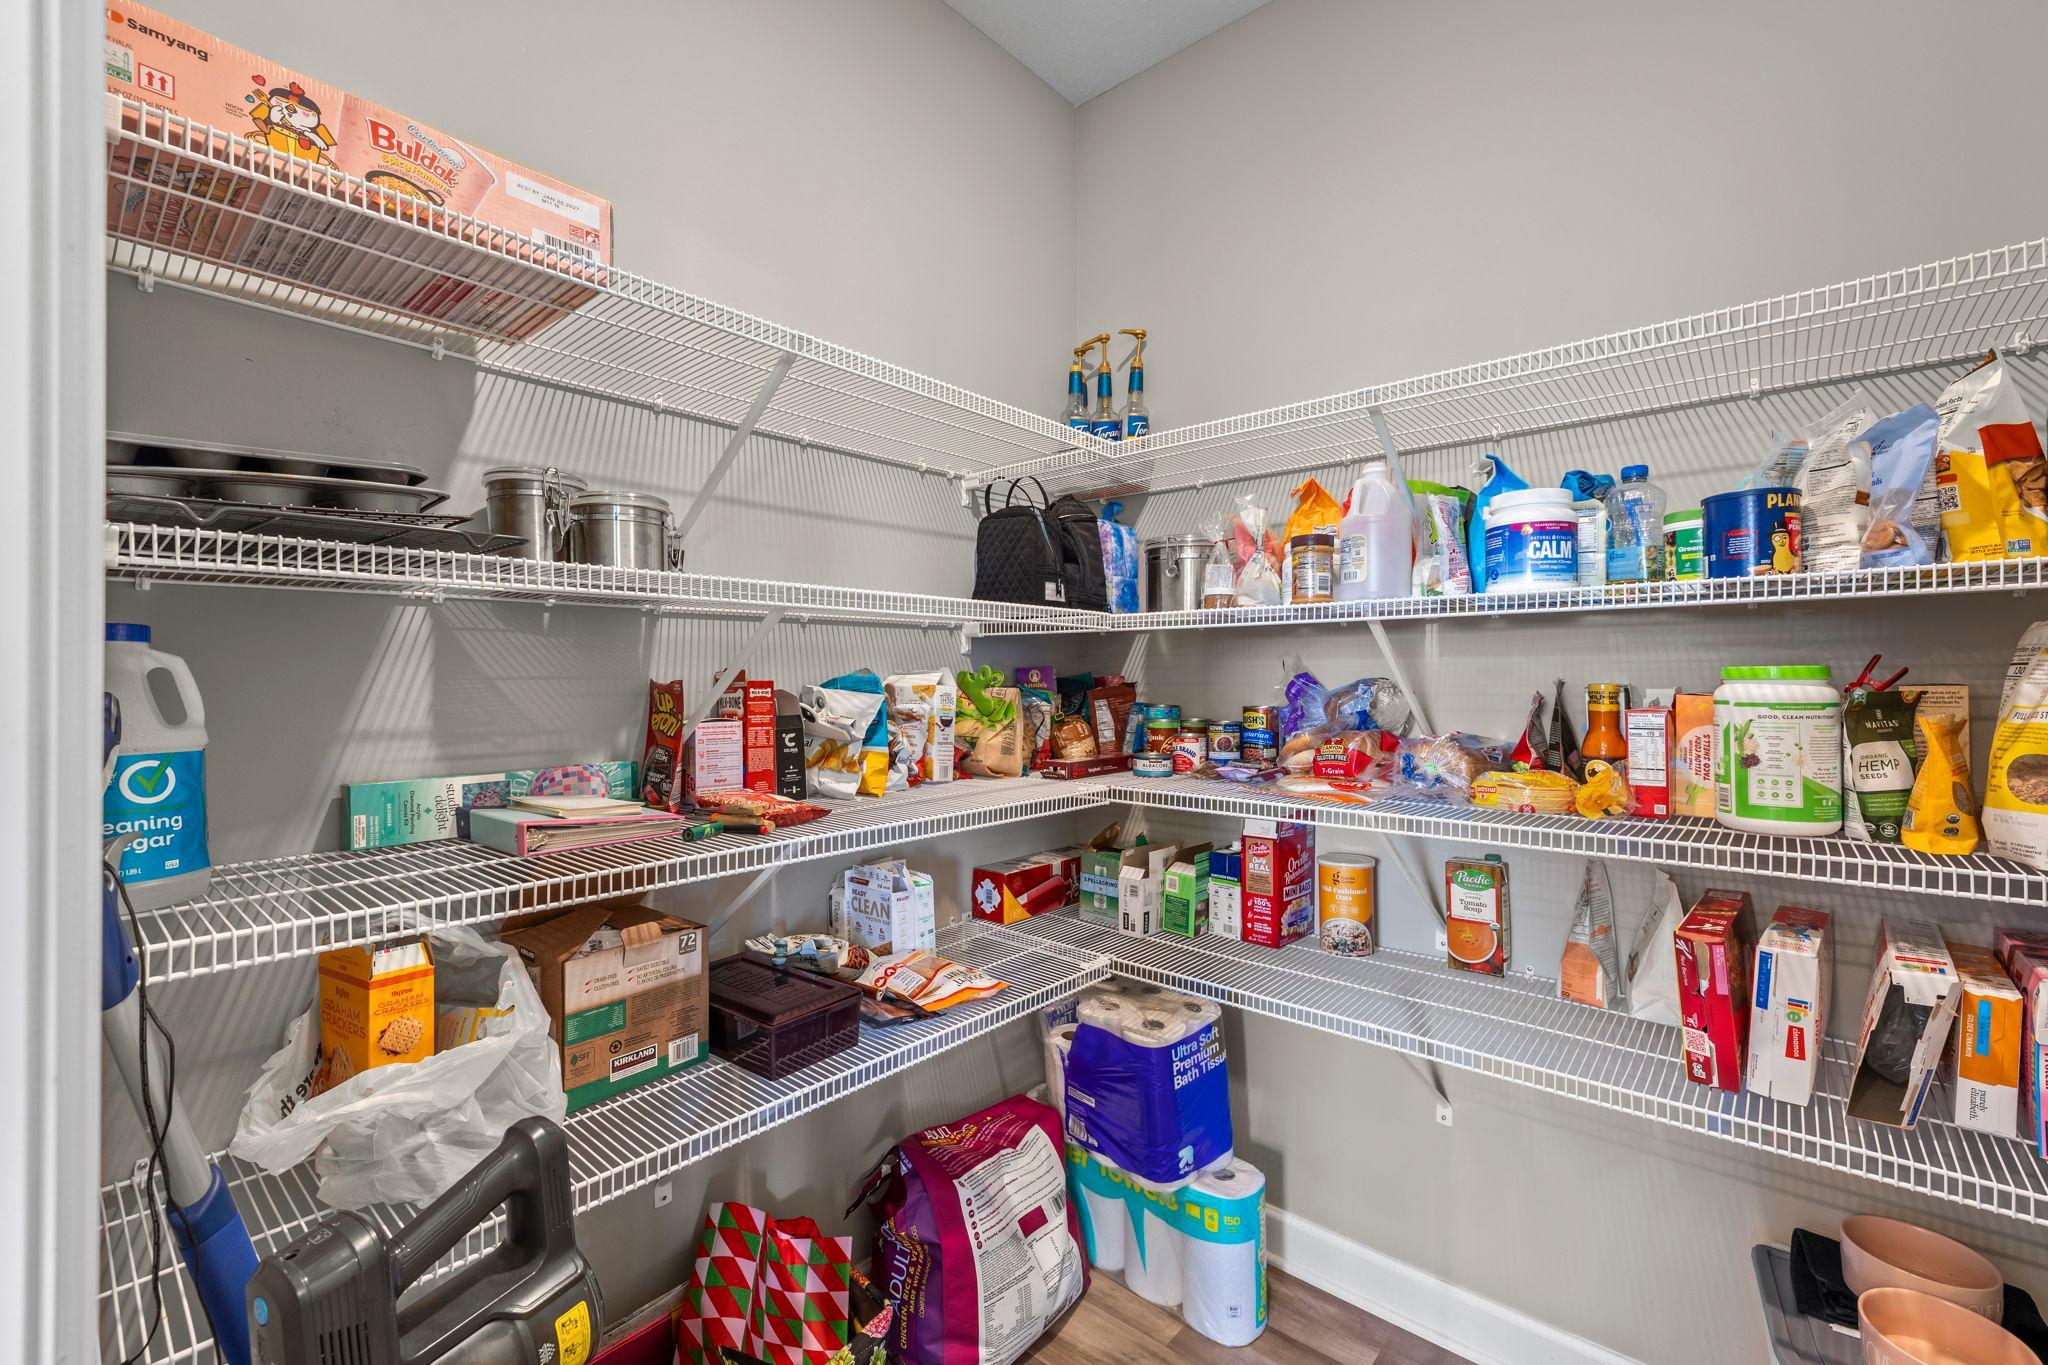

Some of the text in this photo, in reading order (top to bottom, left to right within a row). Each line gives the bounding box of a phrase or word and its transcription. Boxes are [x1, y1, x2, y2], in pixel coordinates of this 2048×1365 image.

[127, 17, 208, 62] Samyang
[366, 118, 458, 187] Buldak
[1528, 541, 1572, 559] CALM
[2014, 666, 2026, 675] 130
[1865, 719, 1899, 729] NAVITAS
[1180, 745, 1197, 758] BRAND
[1703, 733, 1711, 781] TACO SHELLS
[1858, 758, 1900, 772] HEMP
[445, 783, 457, 817] studio
[1249, 863, 1270, 872] REAL
[1252, 857, 1266, 865] Only
[1288, 852, 1309, 873] Orville
[1455, 870, 1490, 885] Pacific
[852, 888, 867, 897] READY
[1285, 881, 1311, 898] MINI BAGS
[1335, 893, 1352, 901] Oats
[851, 895, 890, 920] CLEAN
[1253, 899, 1271, 908] 100%
[1458, 898, 1488, 908] Tomato
[1463, 904, 1483, 914] Soup
[680, 933, 696, 948] 72
[324, 998, 361, 1023] GRAHAM
[374, 997, 430, 1016] CRACKERS
[378, 993, 424, 1009] GRAHAM
[321, 1010, 367, 1040] CRACKERS
[1966, 1013, 1974, 1034] GOLDEN
[1172, 1025, 1220, 1062] Ultra Soft
[1792, 1028, 1800, 1058] cinnamon
[614, 1047, 655, 1068] KIRKLAND
[1173, 1042, 1220, 1075] Premium
[1174, 1067, 1199, 1090] Bath
[1978, 1090, 1988, 1113] purely
[1223, 1215, 1241, 1226] 150
[891, 1243, 912, 1318] ADULT
[903, 1282, 912, 1301] RICE
